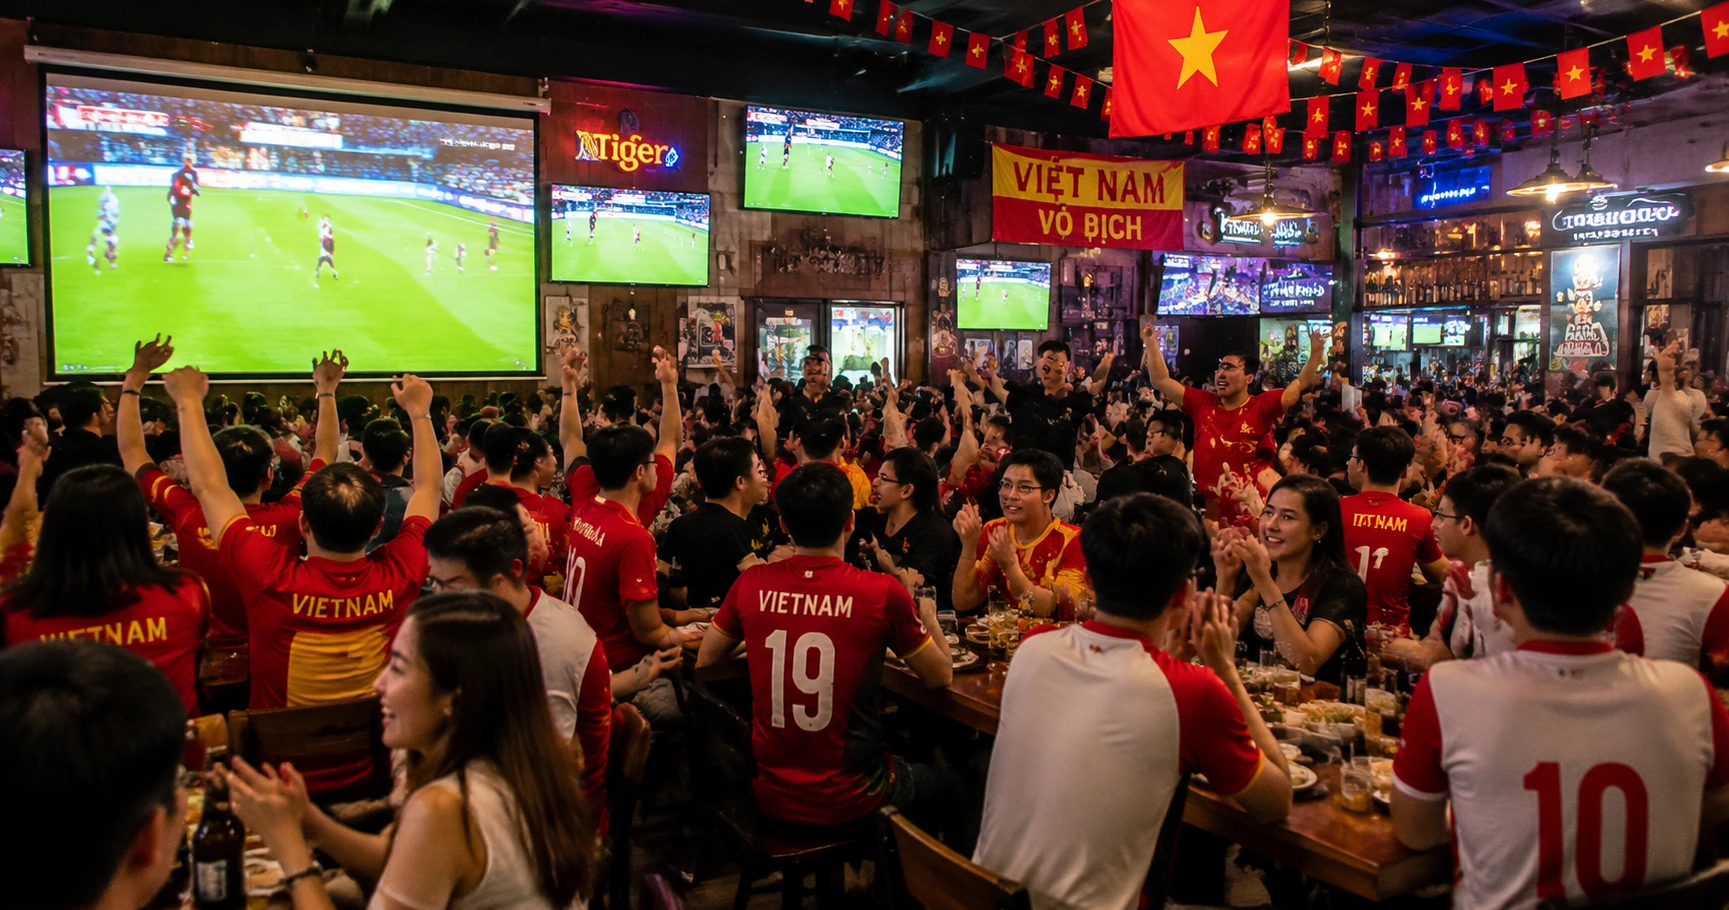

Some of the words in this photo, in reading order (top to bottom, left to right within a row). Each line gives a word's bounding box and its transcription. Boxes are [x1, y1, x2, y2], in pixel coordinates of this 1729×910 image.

[593, 133, 669, 172] Tiger
[1097, 169, 1165, 204] NAM
[292, 589, 394, 619] VIETNAM
[759, 590, 854, 618] VIETNAM
[765, 629, 836, 732] 19
[1523, 760, 1649, 903] 10
